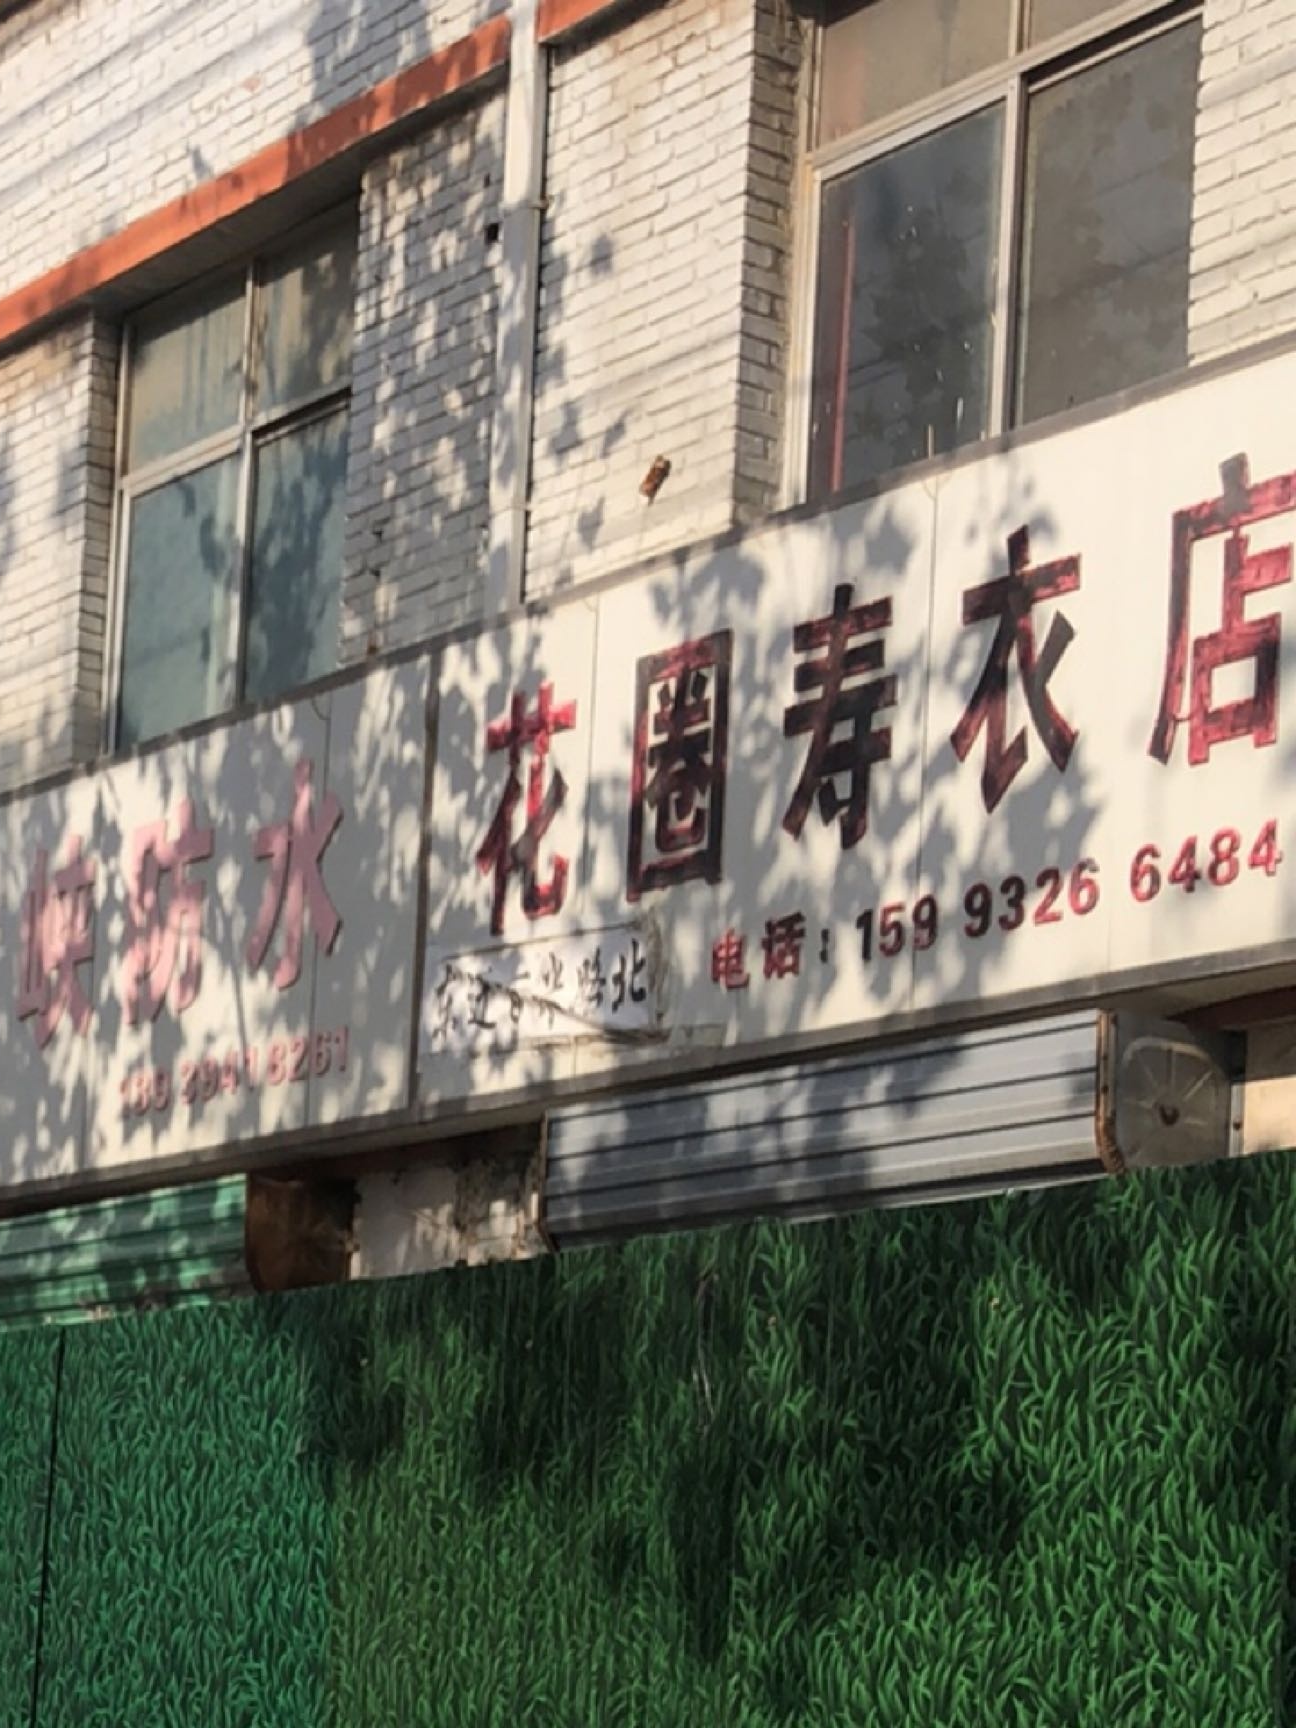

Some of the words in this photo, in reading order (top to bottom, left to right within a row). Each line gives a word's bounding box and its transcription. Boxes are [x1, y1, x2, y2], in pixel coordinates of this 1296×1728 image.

[478, 452, 1296, 938] 花圈寿衣店
[855, 894, 938, 962] 159
[963, 857, 1100, 938] 9326
[1129, 818, 1284, 903] 6484
